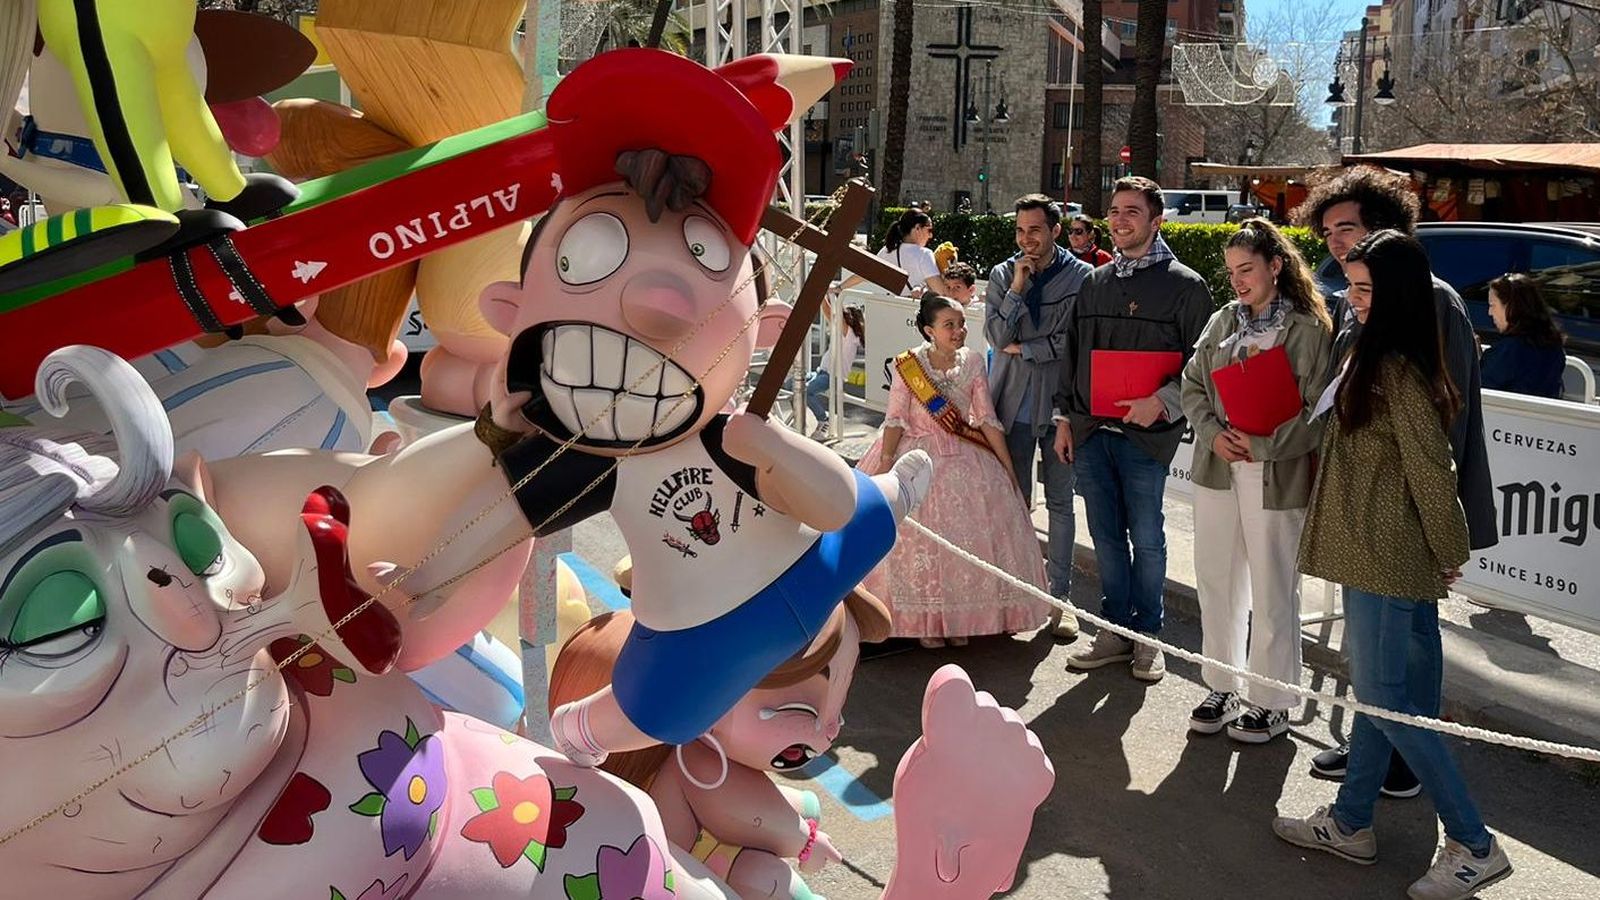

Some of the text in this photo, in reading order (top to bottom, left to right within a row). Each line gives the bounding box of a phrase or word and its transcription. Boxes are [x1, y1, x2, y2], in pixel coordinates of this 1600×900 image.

[369, 183, 521, 259] ALPINO
[1492, 429, 1577, 456] CERVEZAS
[1172, 467, 1192, 481] 890
[674, 487, 703, 511] CLUB
[1479, 557, 1577, 595] SINCE 1890
[1313, 826, 1332, 841] N
[1454, 865, 1478, 884] N
